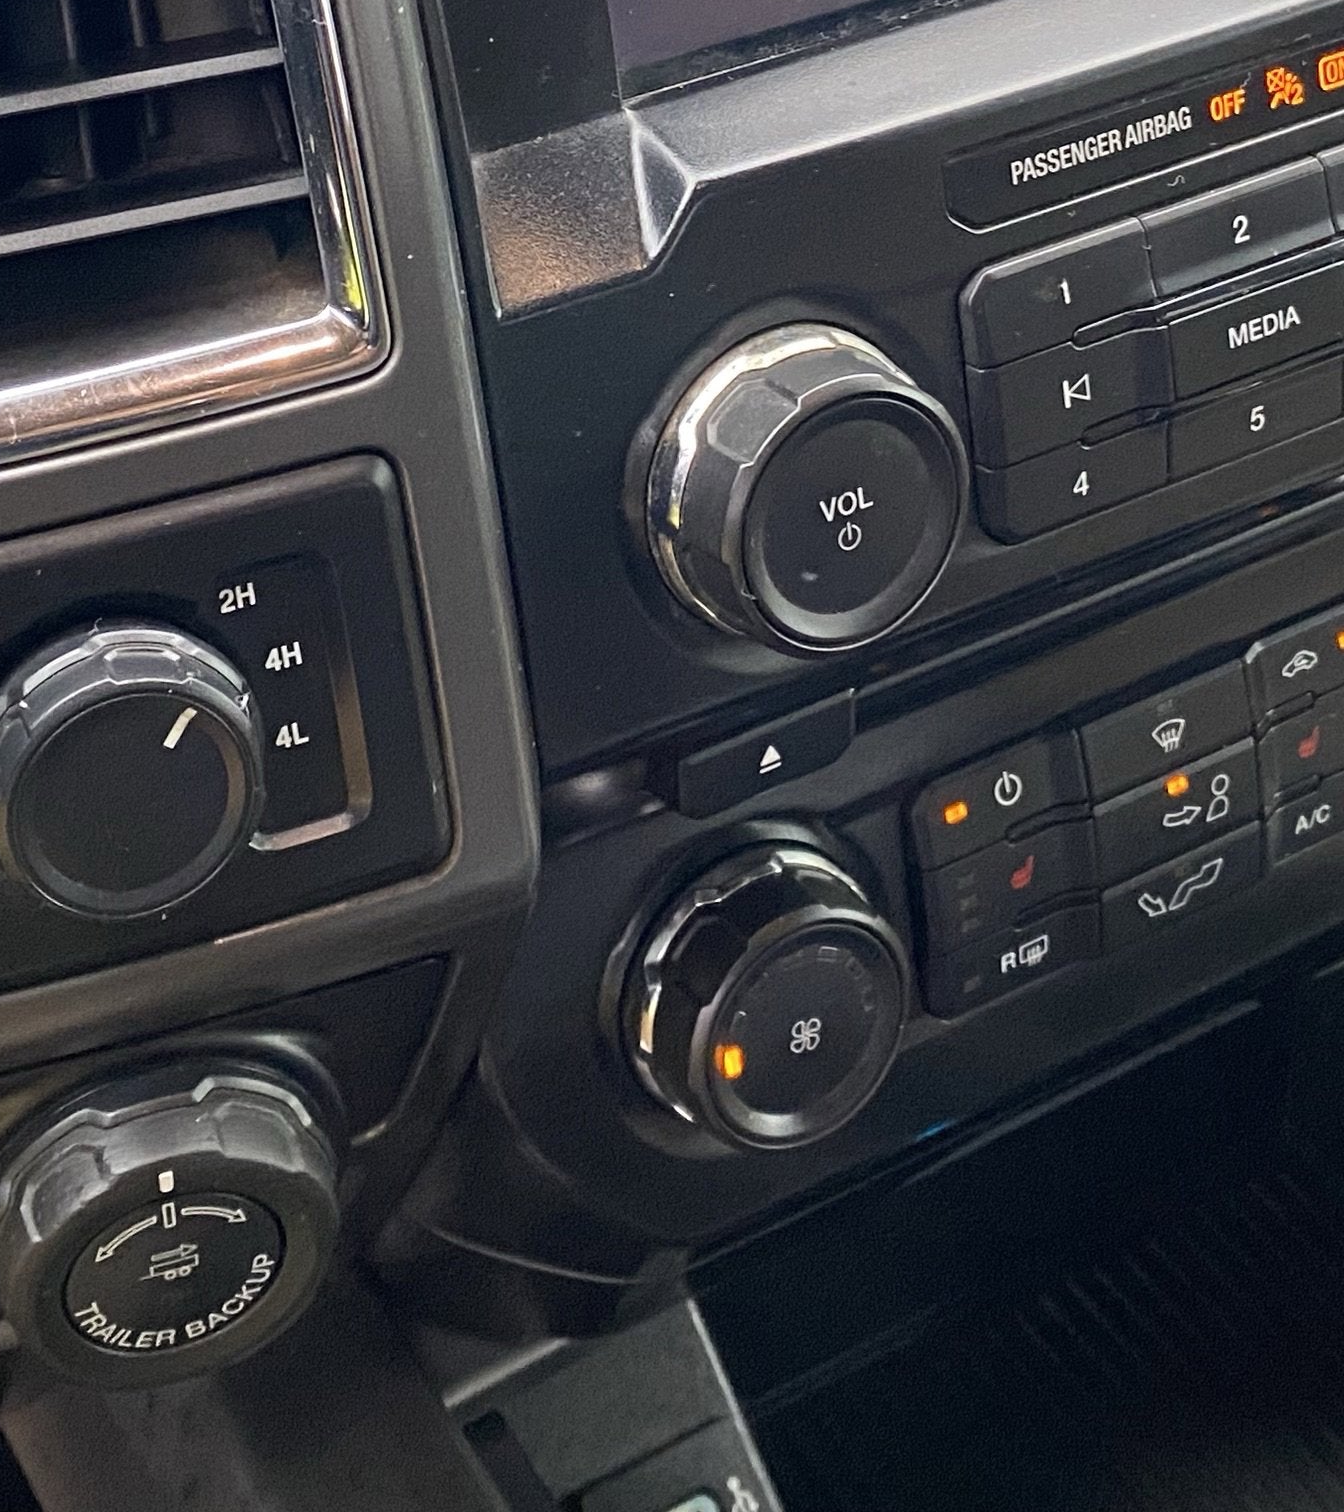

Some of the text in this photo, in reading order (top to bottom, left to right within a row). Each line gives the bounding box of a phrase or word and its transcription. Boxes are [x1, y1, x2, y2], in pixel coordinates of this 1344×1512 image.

[1010, 89, 1246, 185] PASSENGER AIRBAG OFF
[1233, 216, 1250, 244] 2
[1060, 280, 1071, 305] 1
[1227, 306, 1301, 350] MEDIA
[1250, 406, 1265, 431] 5
[1073, 472, 1089, 498] 4
[819, 487, 874, 522] VOL
[218, 582, 256, 614] 2H
[264, 642, 303, 672] 4H
[274, 722, 310, 749] 4L
[1295, 804, 1332, 835] A/C
[1000, 952, 1016, 972] R
[73, 1253, 276, 1350] TRAILER BACKUP
